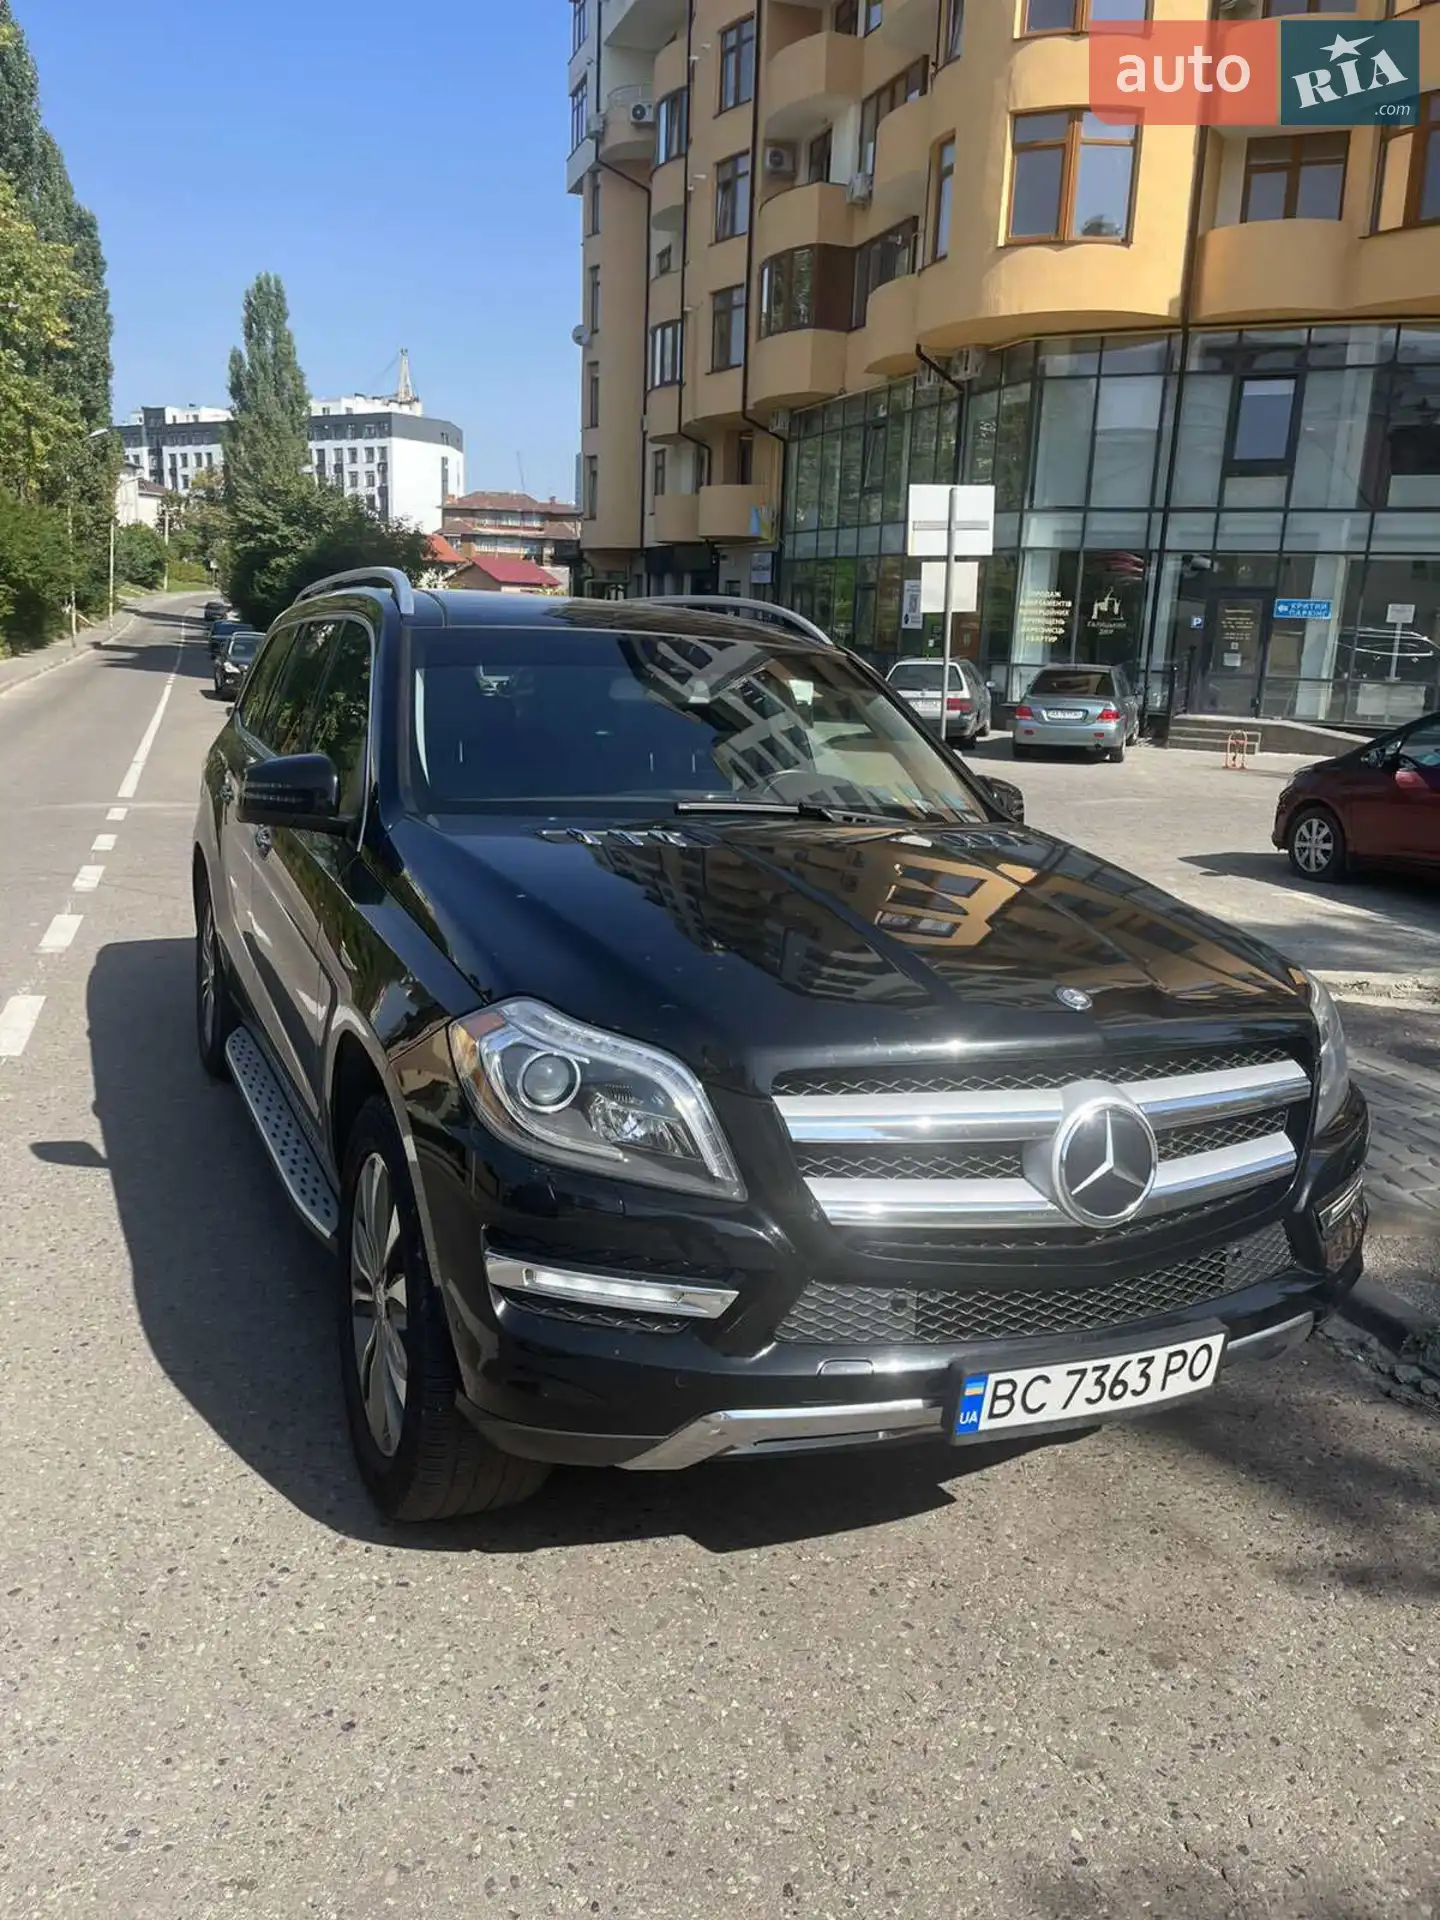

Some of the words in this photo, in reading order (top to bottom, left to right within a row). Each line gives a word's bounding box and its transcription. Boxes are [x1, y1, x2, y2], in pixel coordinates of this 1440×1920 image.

[987, 1374, 1051, 1420] BC
[1062, 1355, 1155, 1410] 7363
[1160, 1343, 1213, 1391] PO
[959, 1412, 978, 1424] UA
